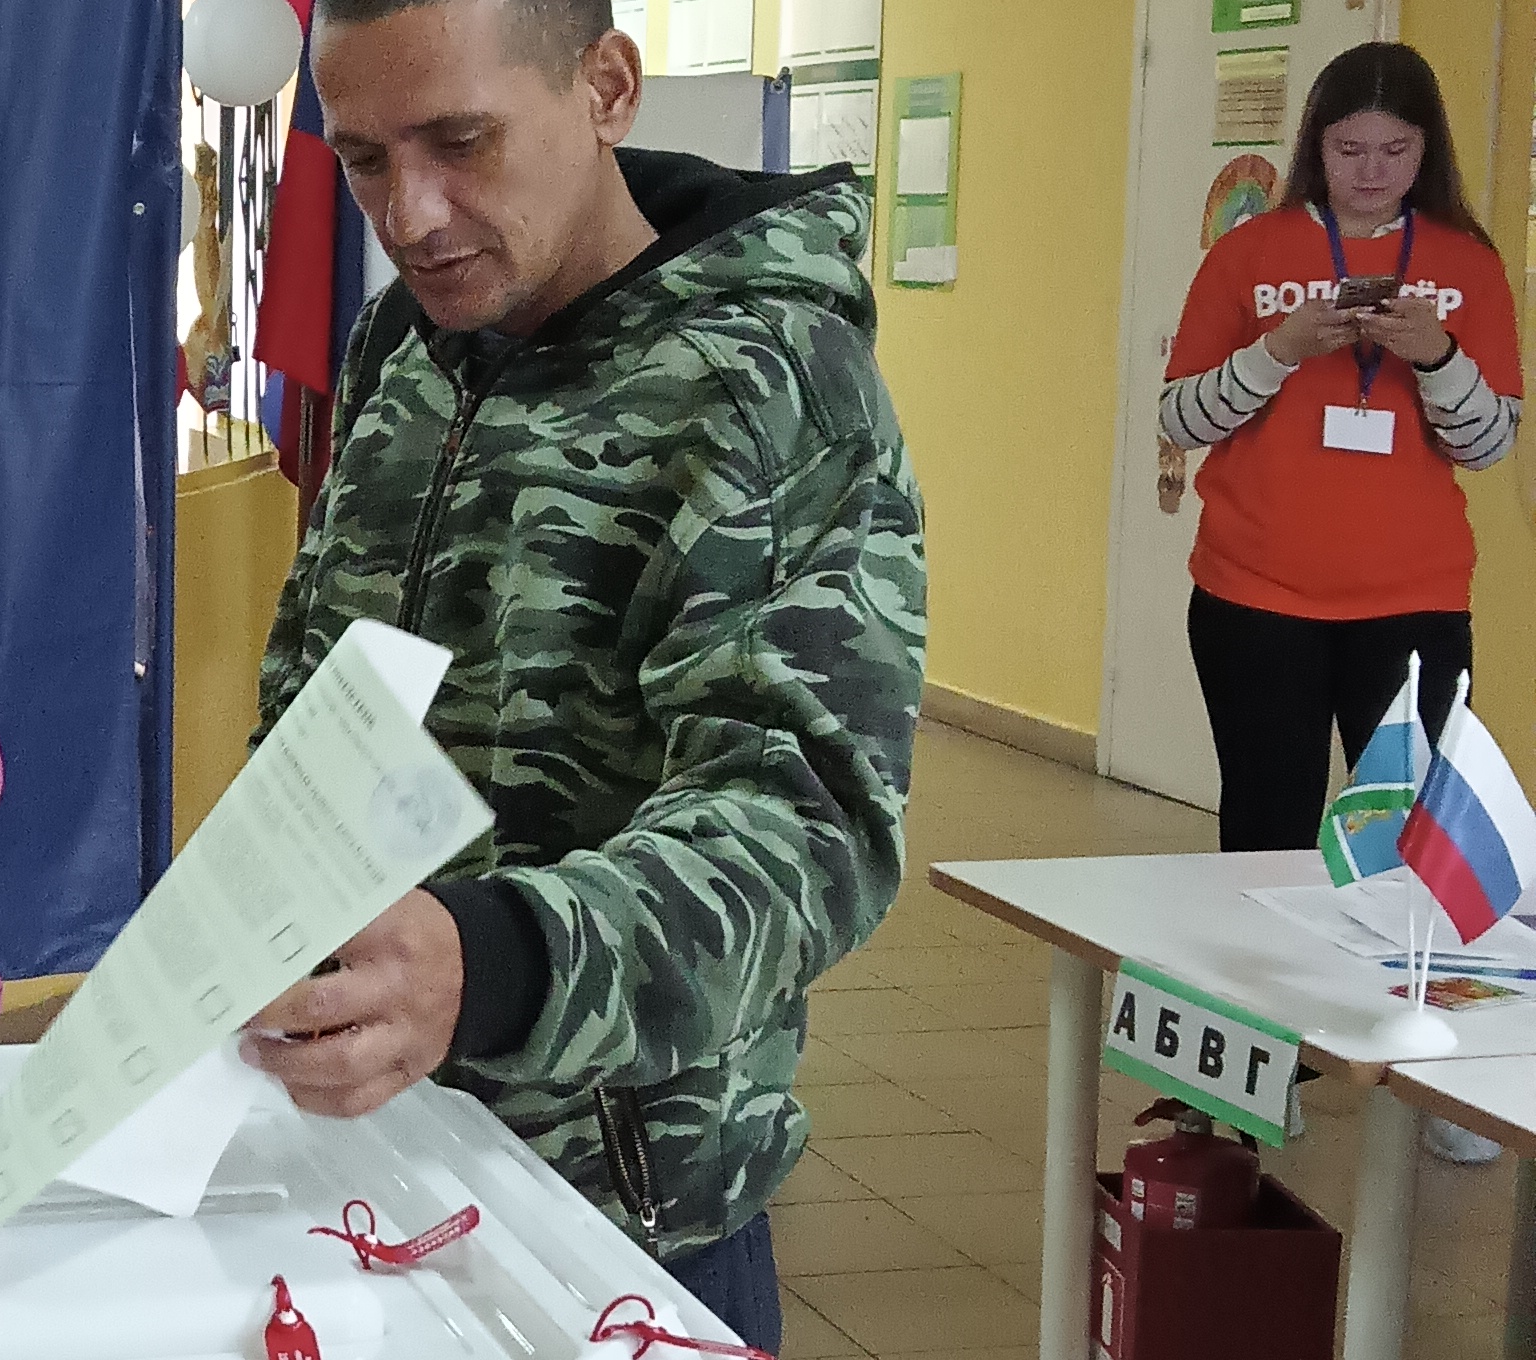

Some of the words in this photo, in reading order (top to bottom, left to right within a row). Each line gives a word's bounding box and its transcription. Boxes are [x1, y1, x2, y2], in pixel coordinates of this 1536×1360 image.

[1113, 991, 1136, 1042] А
[1155, 1005, 1181, 1059] Б
[1198, 1026, 1224, 1079] В
[1246, 1044, 1270, 1096] Г
